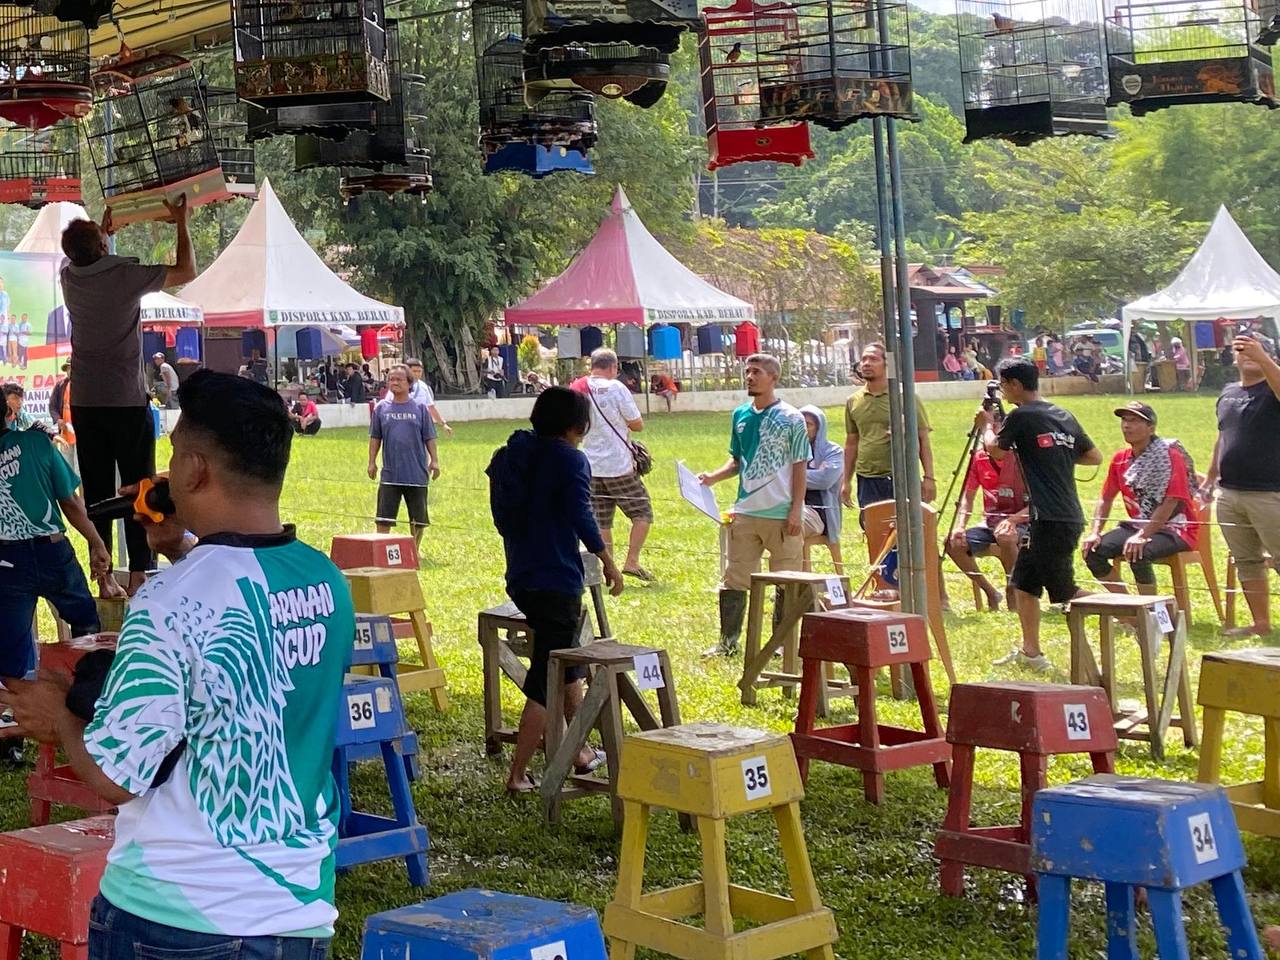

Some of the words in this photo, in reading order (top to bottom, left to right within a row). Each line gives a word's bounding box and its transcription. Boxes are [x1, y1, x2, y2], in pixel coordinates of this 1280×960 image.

[154, 307, 189, 320] BERAU
[280, 311, 328, 323] DISPORA
[329, 311, 355, 322] KAB.
[357, 310, 391, 322] BERAU
[657, 309, 695, 320] DISPORA
[696, 309, 716, 320] KAB.
[718, 308, 745, 319] BERAU
[1, 460, 21, 481] CUP
[388, 548, 400, 561] 63
[832, 585, 843, 599] 61
[269, 581, 335, 629] ARMAN
[283, 622, 327, 667] CUP
[889, 630, 906, 648] 52
[643, 664, 660, 682] 44
[350, 701, 373, 722] 36
[1067, 712, 1088, 732] 43
[745, 765, 769, 791] 35
[1193, 823, 1214, 853] 34
